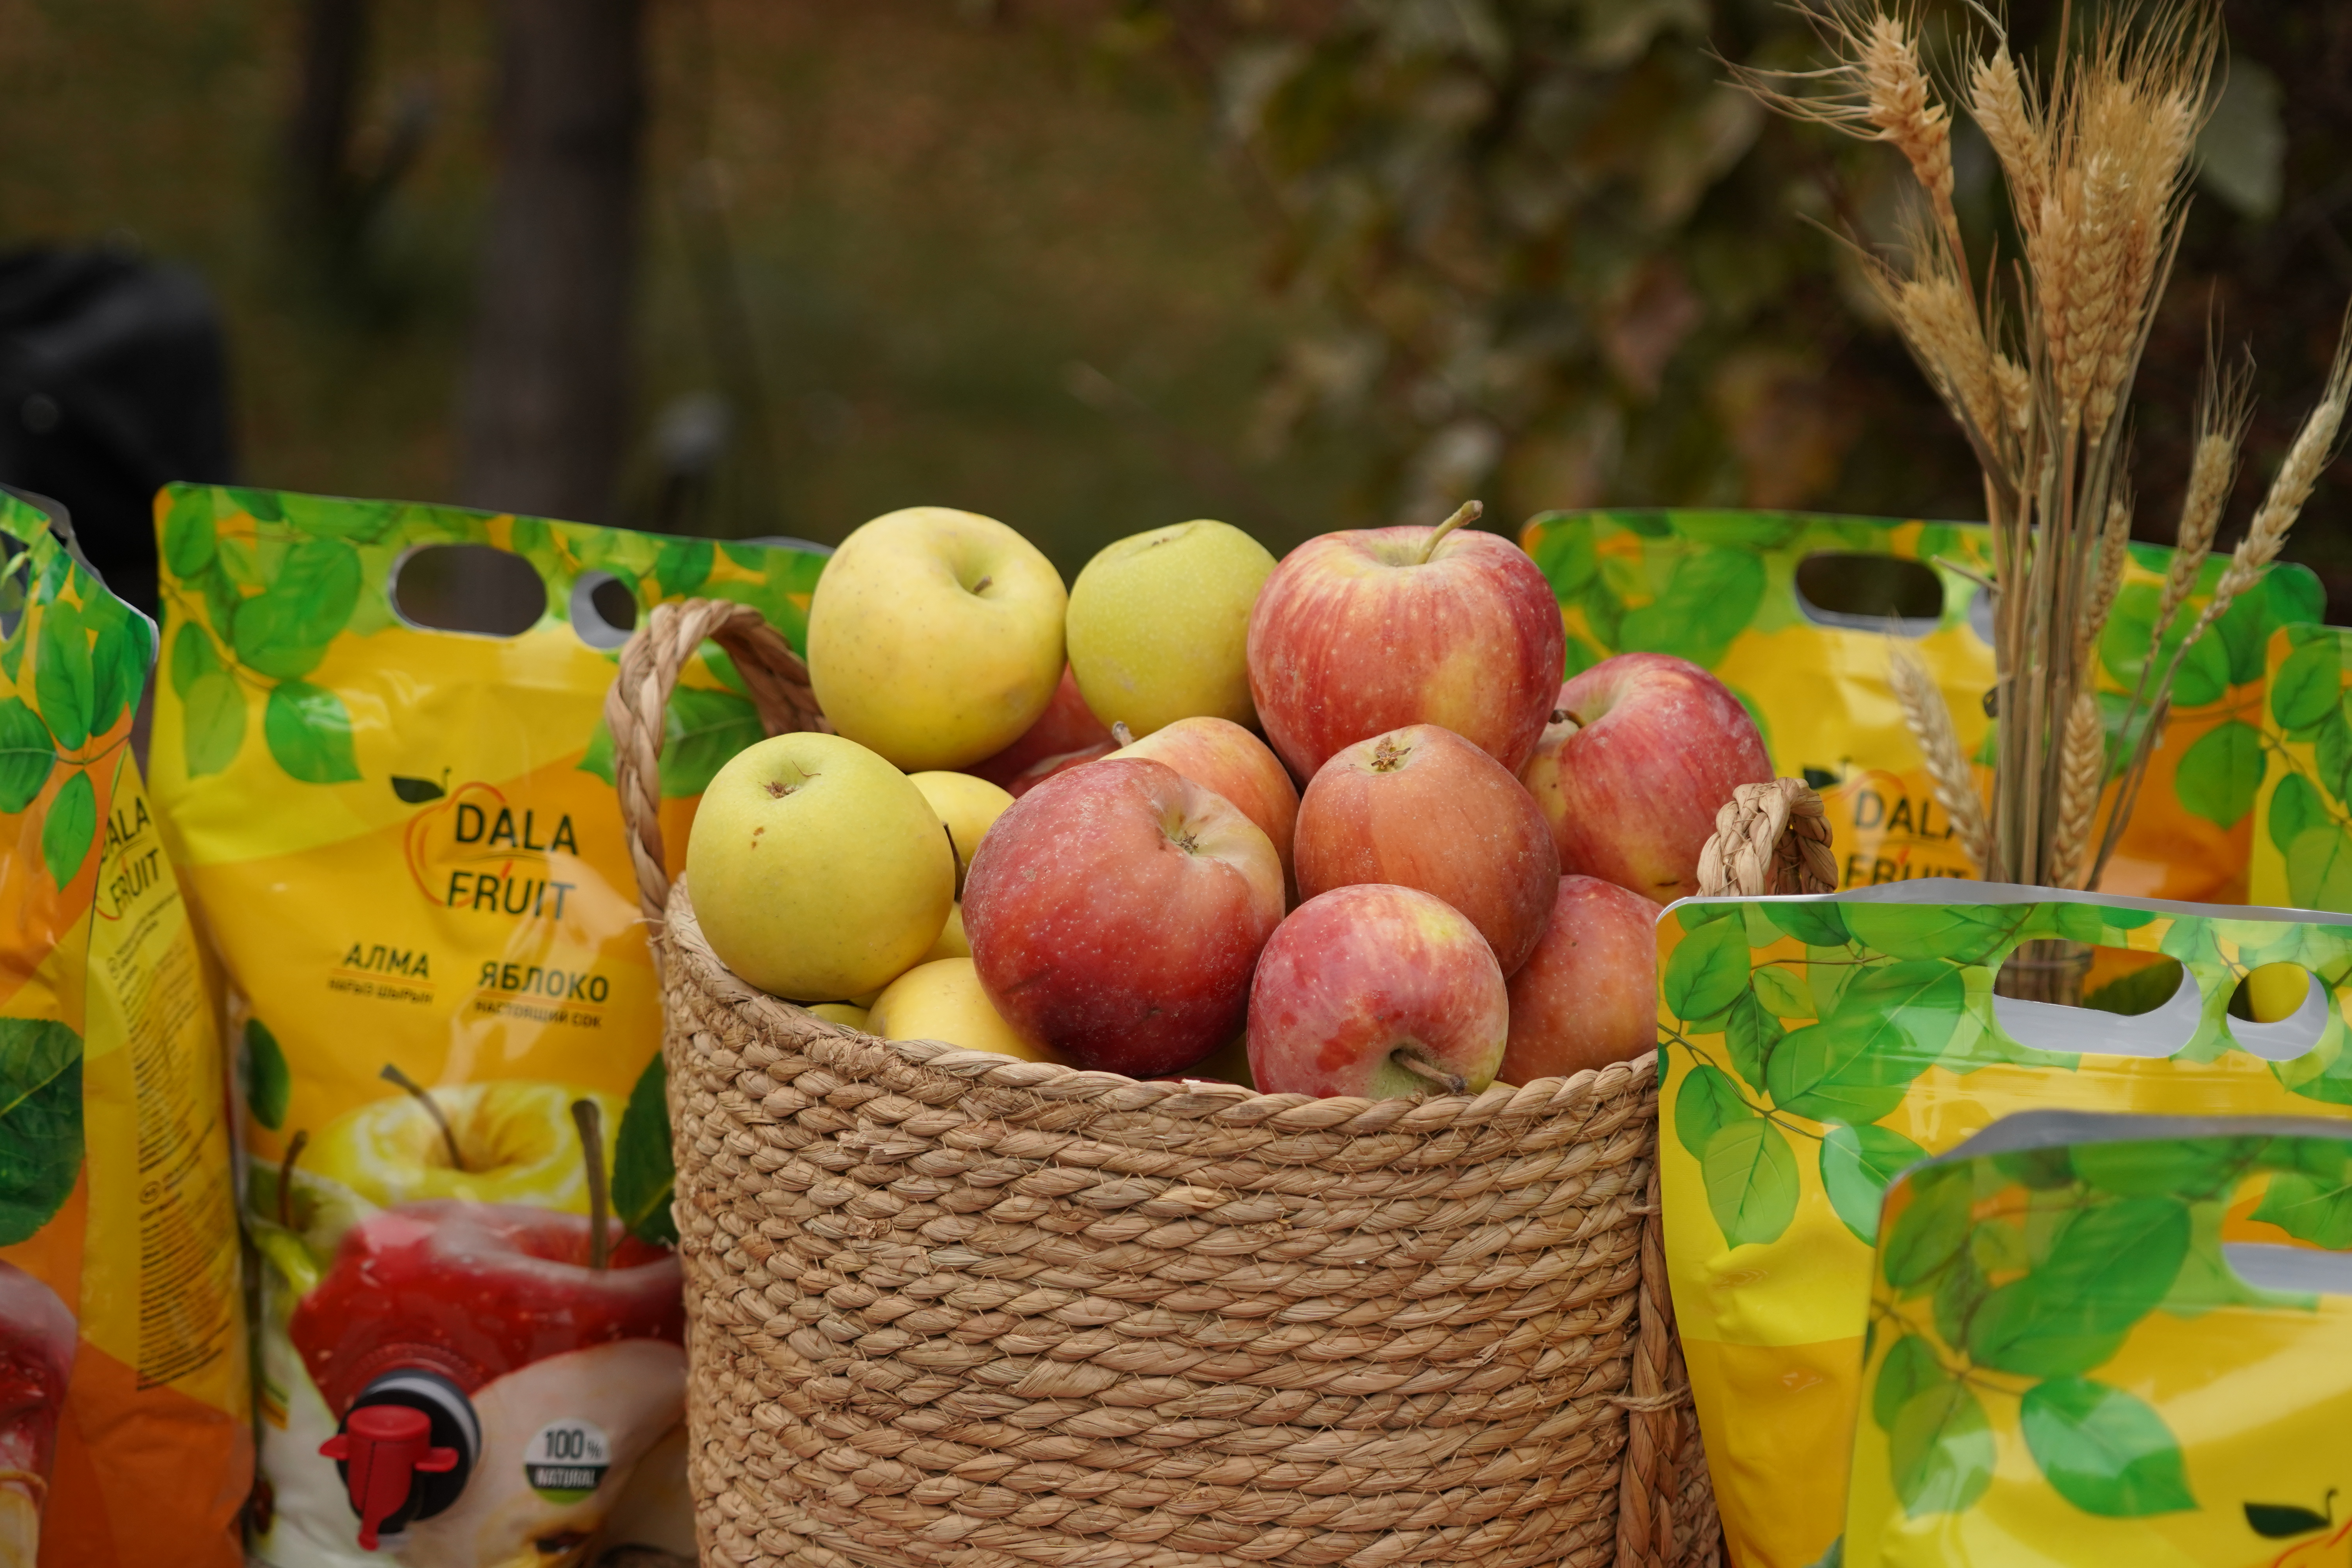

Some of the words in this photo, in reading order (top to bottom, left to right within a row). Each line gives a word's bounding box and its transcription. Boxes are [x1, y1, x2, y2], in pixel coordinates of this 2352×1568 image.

[100, 796, 152, 865] ALA
[456, 802, 579, 856] DALA
[1853, 791, 1955, 840] DAL
[447, 870, 576, 919] FRUIT
[342, 941, 430, 979] АЛМА
[477, 960, 610, 1004] ЯБЛОКО
[474, 998, 568, 1024] НАСТОЯЩИЙ
[571, 1011, 602, 1029] СОК
[544, 1428, 602, 1460] 100%
[534, 1467, 595, 1488] NATURAL
